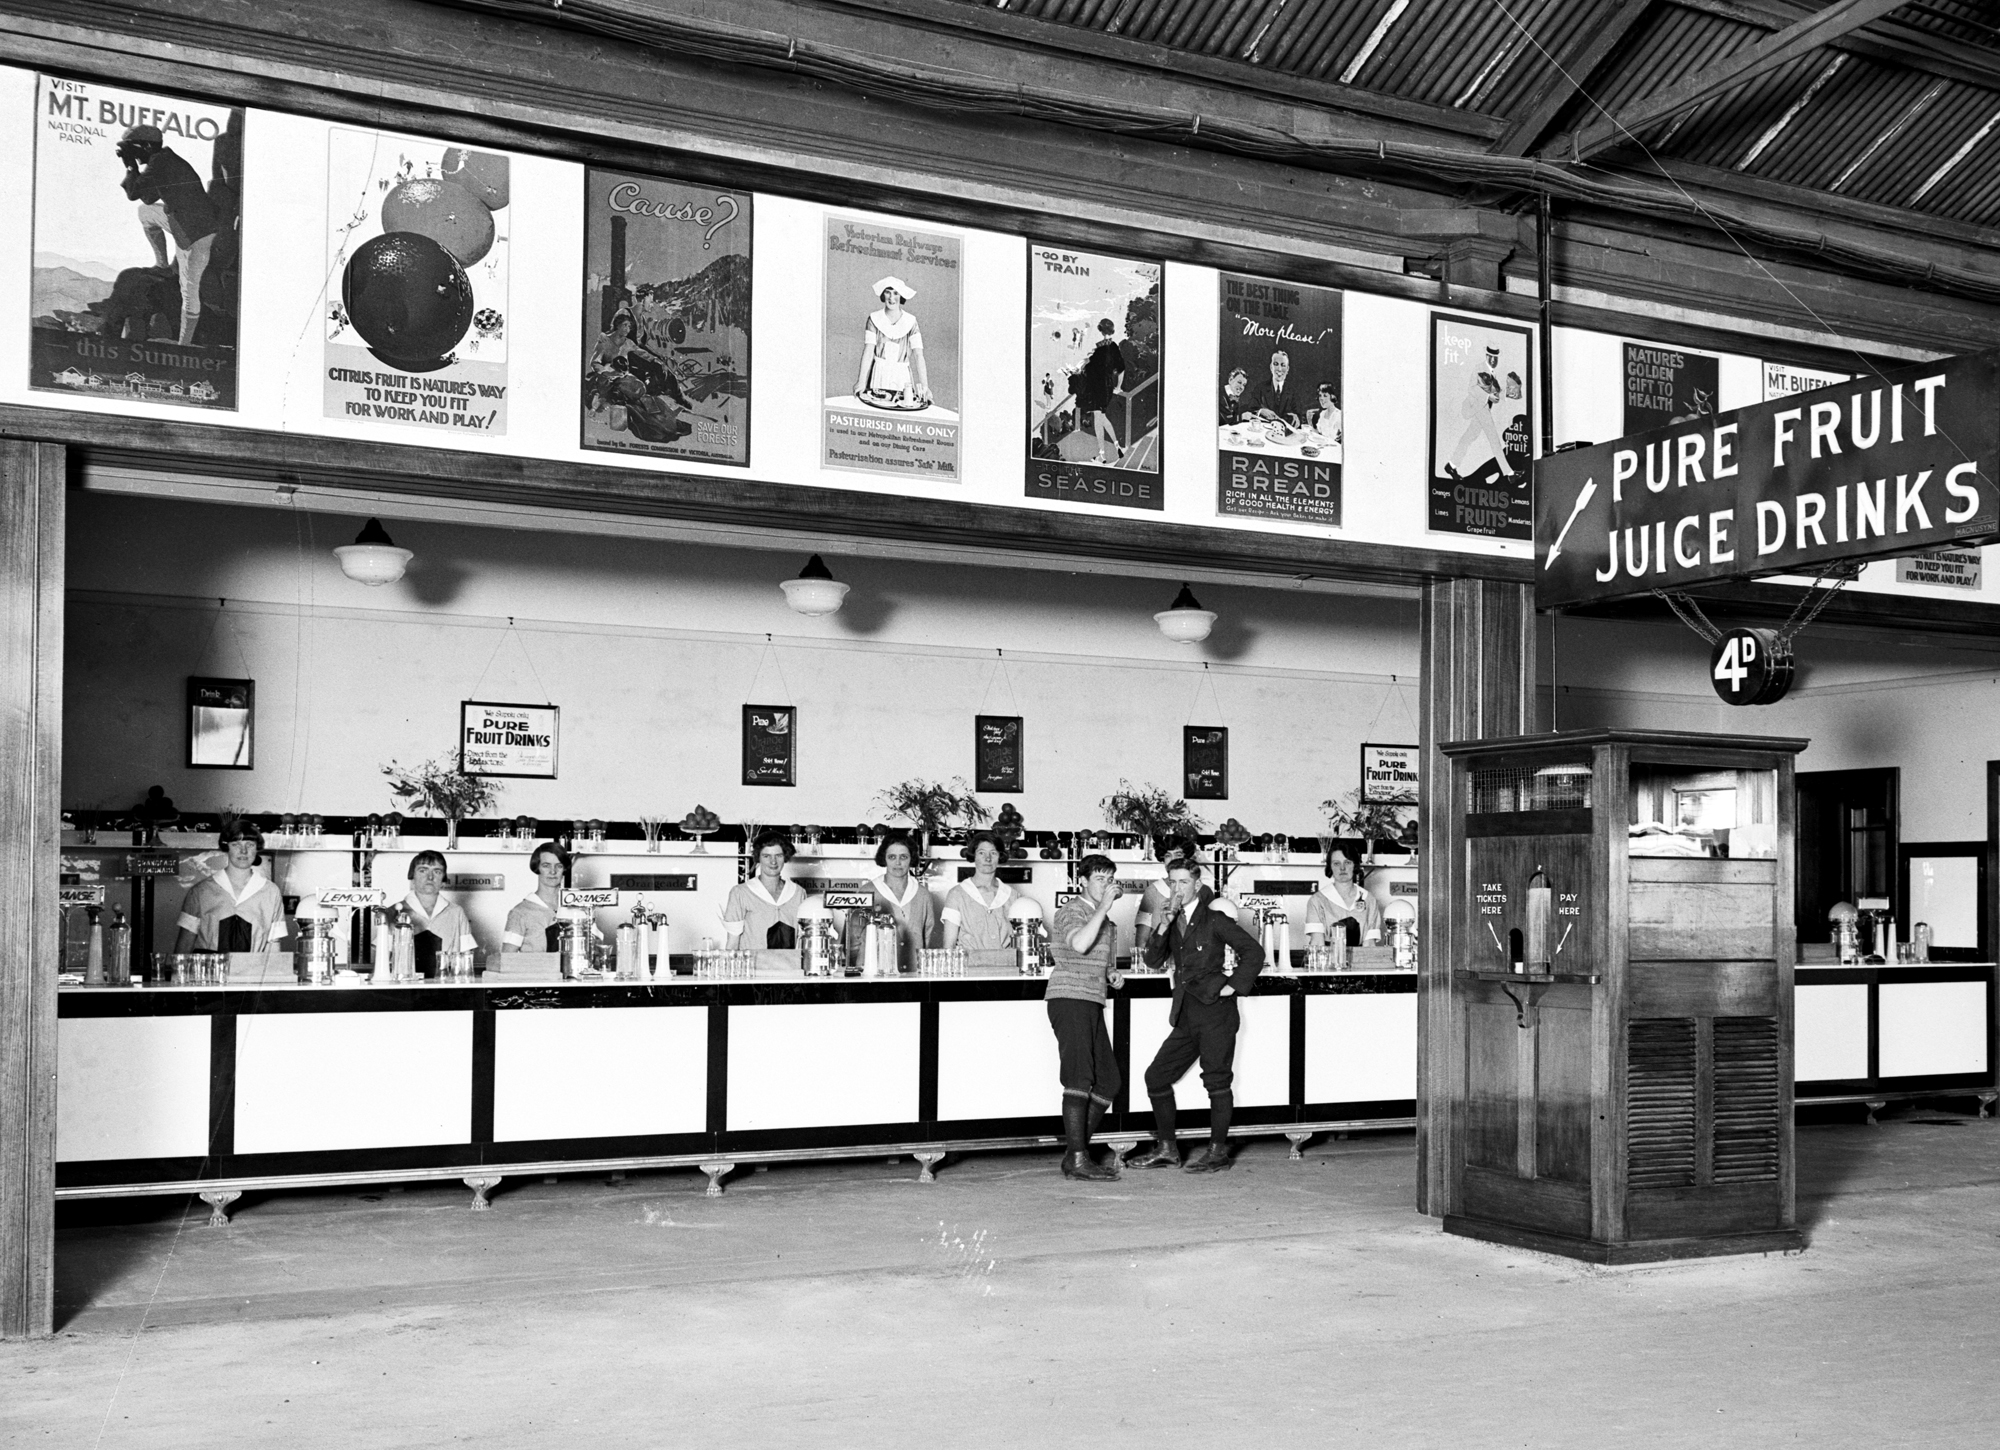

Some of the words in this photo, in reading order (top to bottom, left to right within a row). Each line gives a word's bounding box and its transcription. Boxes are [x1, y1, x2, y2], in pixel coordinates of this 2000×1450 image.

[51, 79, 86, 94] VISIT
[49, 91, 92, 122] MT.
[99, 99, 220, 141] BUFFALO
[48, 120, 107, 138] NATIONAL
[59, 132, 92, 146] PARK
[608, 182, 739, 250] Cause?
[844, 224, 894, 245] Victorian
[895, 233, 943, 255] Railways
[829, 235, 903, 261] Refreshment
[906, 248, 957, 269] Services
[1062, 254, 1078, 264] BY
[1044, 261, 1090, 277] TRAIN
[1226, 279, 1244, 296] THE
[1246, 282, 1270, 301] BEST
[1272, 287, 1300, 306] THING
[1226, 297, 1241, 313] ON
[1243, 300, 1260, 316] THE
[1262, 302, 1289, 321] TABLE
[76, 337, 119, 360] this
[130, 343, 227, 371] Summer
[1628, 347, 1685, 369] NATURE'S
[1627, 361, 1674, 382] GOLDEN
[1768, 364, 1785, 373] VISIT
[328, 367, 374, 385] CITRUS
[375, 372, 408, 389] FRUIT
[410, 377, 421, 389] IS
[423, 378, 477, 396] NATURE'S
[478, 384, 506, 399] WAY
[1627, 377, 1655, 394] GIFT
[1657, 381, 1673, 397] TO
[1768, 372, 1788, 391] MT.
[364, 387, 381, 402] TO
[384, 389, 417, 405] KEEP
[419, 393, 448, 409] YOU
[450, 397, 470, 411] FIT
[1628, 392, 1673, 412] HEALTH
[345, 401, 371, 417] FOR
[373, 404, 417, 421] WORK
[419, 409, 449, 425] AND
[453, 410, 497, 429] PLAY!
[697, 421, 719, 433] SAVE
[721, 423, 738, 435] OUR
[829, 414, 893, 431] PASTEURISED
[897, 423, 923, 435] MILK
[926, 426, 956, 438] ONLY
[697, 432, 738, 447] FORESTS
[837, 427, 849, 435] used
[868, 431, 901, 442] Metropolitan
[903, 435, 935, 445] Refreshment
[936, 439, 955, 447] Rooms
[1504, 431, 1529, 443] more
[1613, 423, 1738, 503] PURE
[1773, 373, 1946, 468] FRUIT
[893, 442, 910, 453] Dining
[912, 444, 926, 452] Cars
[829, 448, 883, 465] Pasteurisation
[885, 457, 915, 468] assures
[915, 458, 936, 470] "Safe"
[937, 461, 955, 472] Milk
[1065, 465, 1083, 475] THE
[1232, 456, 1330, 482] RAISIN
[1038, 473, 1151, 499] SEASIDE
[1232, 474, 1330, 498] BREAD
[1431, 488, 1451, 498] Oranges
[1225, 490, 1246, 499] RICH
[1248, 492, 1257, 500] IN
[1259, 494, 1273, 502] ALL
[1275, 495, 1290, 504] THE
[1293, 497, 1335, 508] ELEMENTS
[1453, 484, 1510, 509] CITRUS
[1511, 497, 1530, 506] Lemons
[1225, 497, 1236, 505] OF
[1239, 499, 1263, 508] GOOD
[1266, 501, 1295, 511] HEALTH
[1304, 506, 1334, 515] ENERGY
[1434, 508, 1449, 516] Limes
[1456, 505, 1508, 528] FRUITS
[1595, 509, 1734, 583] JUICE
[1755, 461, 1979, 556] DRINKS
[1466, 525, 1482, 535] Grape
[1955, 522, 1997, 537] MAGNUSYNE
[1914, 560, 1924, 570] TO
[1941, 563, 1954, 573] YOU
[1906, 570, 1919, 581] FOR
[1919, 572, 1940, 583] WORK
[1940, 574, 1956, 585] AND
[1956, 572, 1977, 586] PLAY!
[483, 718, 530, 731] PURE
[466, 727, 504, 745] FRUIT
[505, 731, 551, 748] DRINKS
[1379, 760, 1407, 769] PURE
[1366, 767, 1392, 781] FRUIT
[1393, 769, 1419, 782] DRINK
[455, 874, 491, 886] Lemon
[828, 879, 859, 889] Lemon
[1482, 884, 1502, 893] TAKE
[320, 892, 373, 903] LEMON.
[827, 894, 867, 906] LEMON.
[1476, 895, 1507, 904] TICKETS
[1559, 893, 1578, 902] PAY
[1481, 906, 1502, 915] HERE
[1559, 907, 1580, 916] HERE
